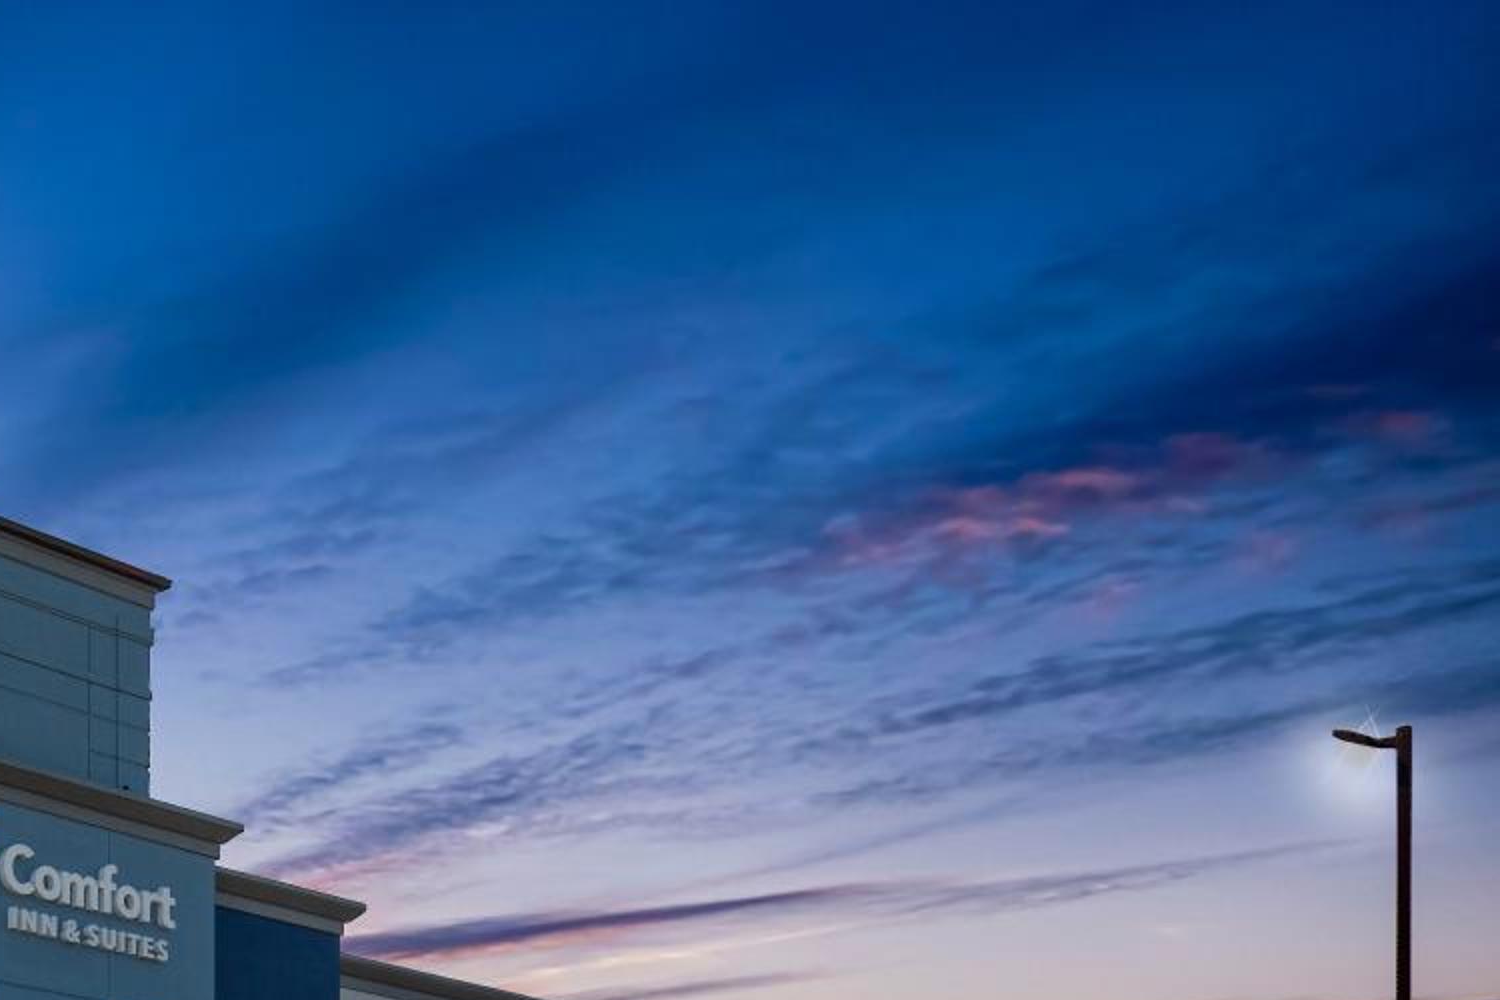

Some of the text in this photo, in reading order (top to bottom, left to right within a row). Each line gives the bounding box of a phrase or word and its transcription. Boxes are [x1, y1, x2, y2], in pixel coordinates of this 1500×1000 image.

[0, 843, 176, 929] Comfort
[7, 906, 169, 961] INN & SUITES
